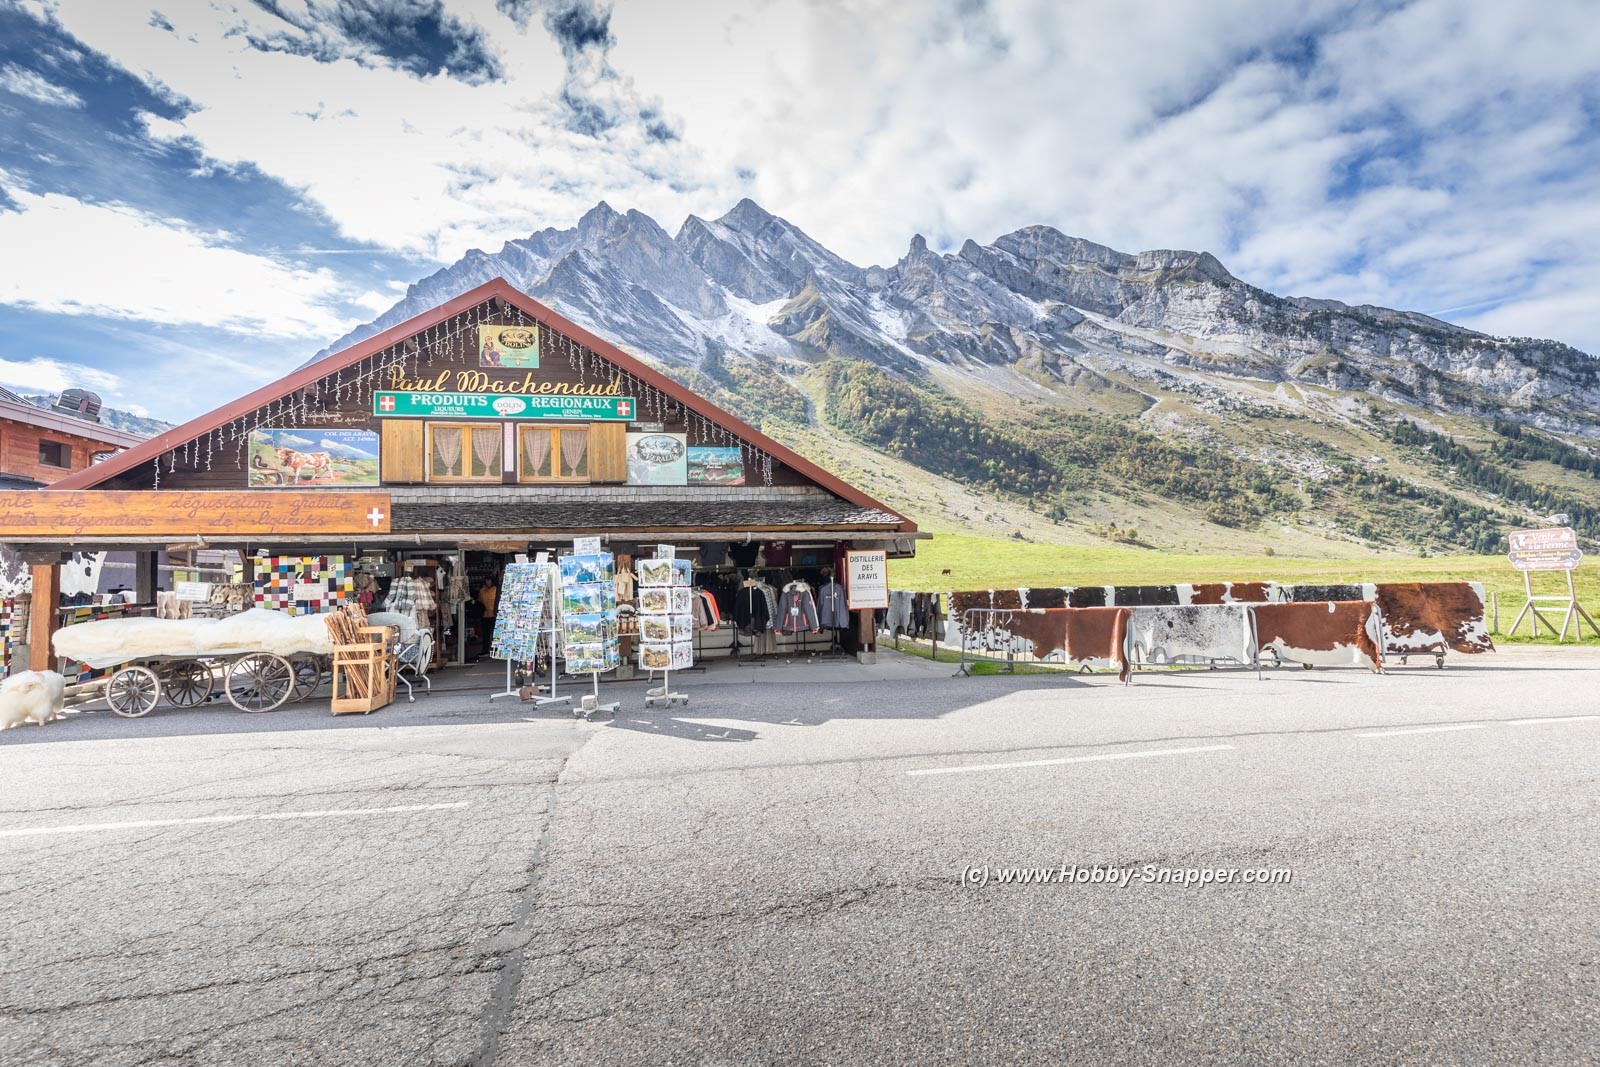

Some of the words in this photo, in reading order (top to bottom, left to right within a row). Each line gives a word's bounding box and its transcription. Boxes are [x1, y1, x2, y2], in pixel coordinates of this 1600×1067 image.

[390, 364, 451, 392] Paul
[457, 369, 622, 396] Machenaud
[410, 394, 488, 407] PRODUITS
[531, 397, 612, 409] REGIONAUX
[56, 493, 86, 509] de
[168, 494, 273, 518] dégustation
[290, 494, 352, 516] gratuite
[208, 511, 233, 527] de
[252, 510, 326, 534] liqueurs
[1543, 541, 1569, 550] Ferme
[849, 555, 885, 563] DISTILLERIE
[861, 564, 874, 572] DES
